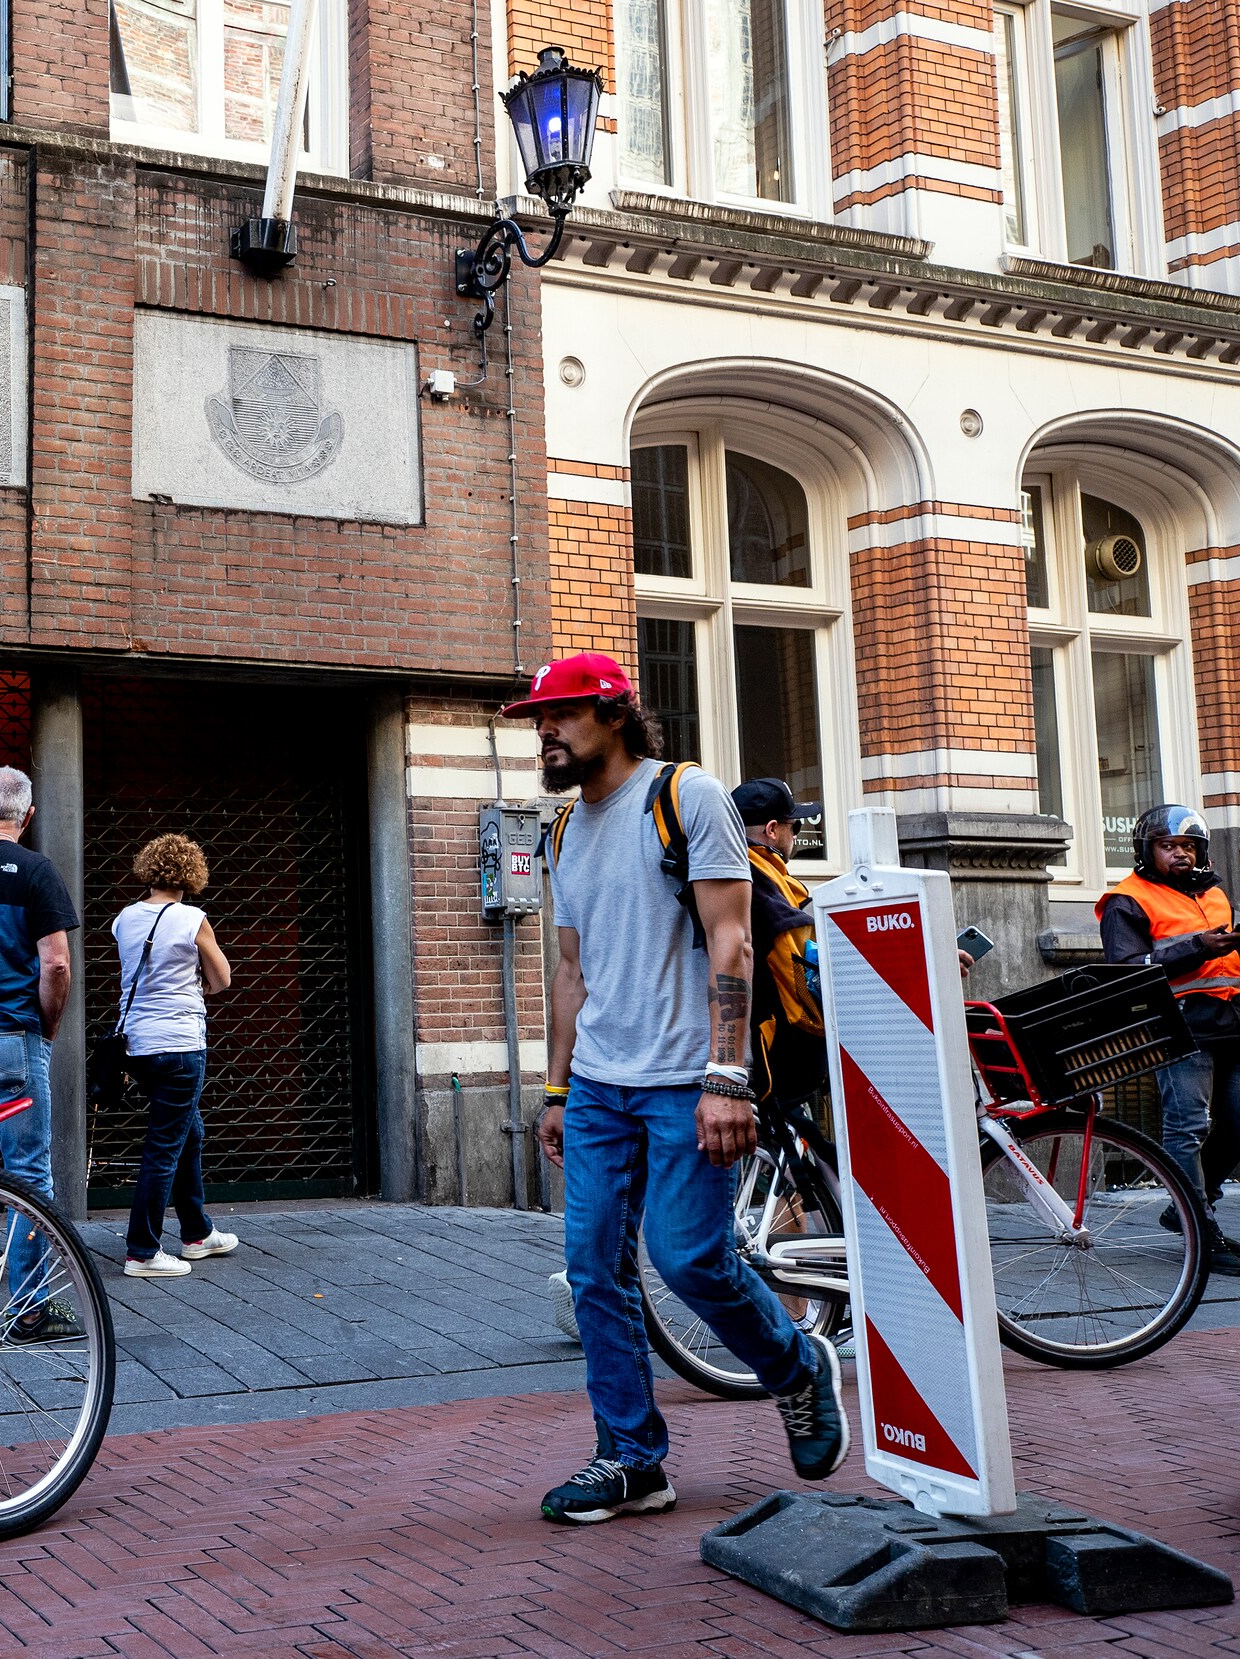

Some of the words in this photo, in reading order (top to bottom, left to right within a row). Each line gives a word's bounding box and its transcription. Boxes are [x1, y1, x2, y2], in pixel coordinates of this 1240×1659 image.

[243, 459, 284, 479] ARDEAT
[508, 832, 533, 845] GEB
[511, 855, 530, 864] BUY
[511, 863, 530, 872] BTC
[866, 912, 915, 932] BUKO.
[1008, 1144, 1045, 1185] BATAVUS
[880, 1205, 930, 1274] Bukoinfrasupport.nl
[881, 1422, 926, 1453] BUKO.
